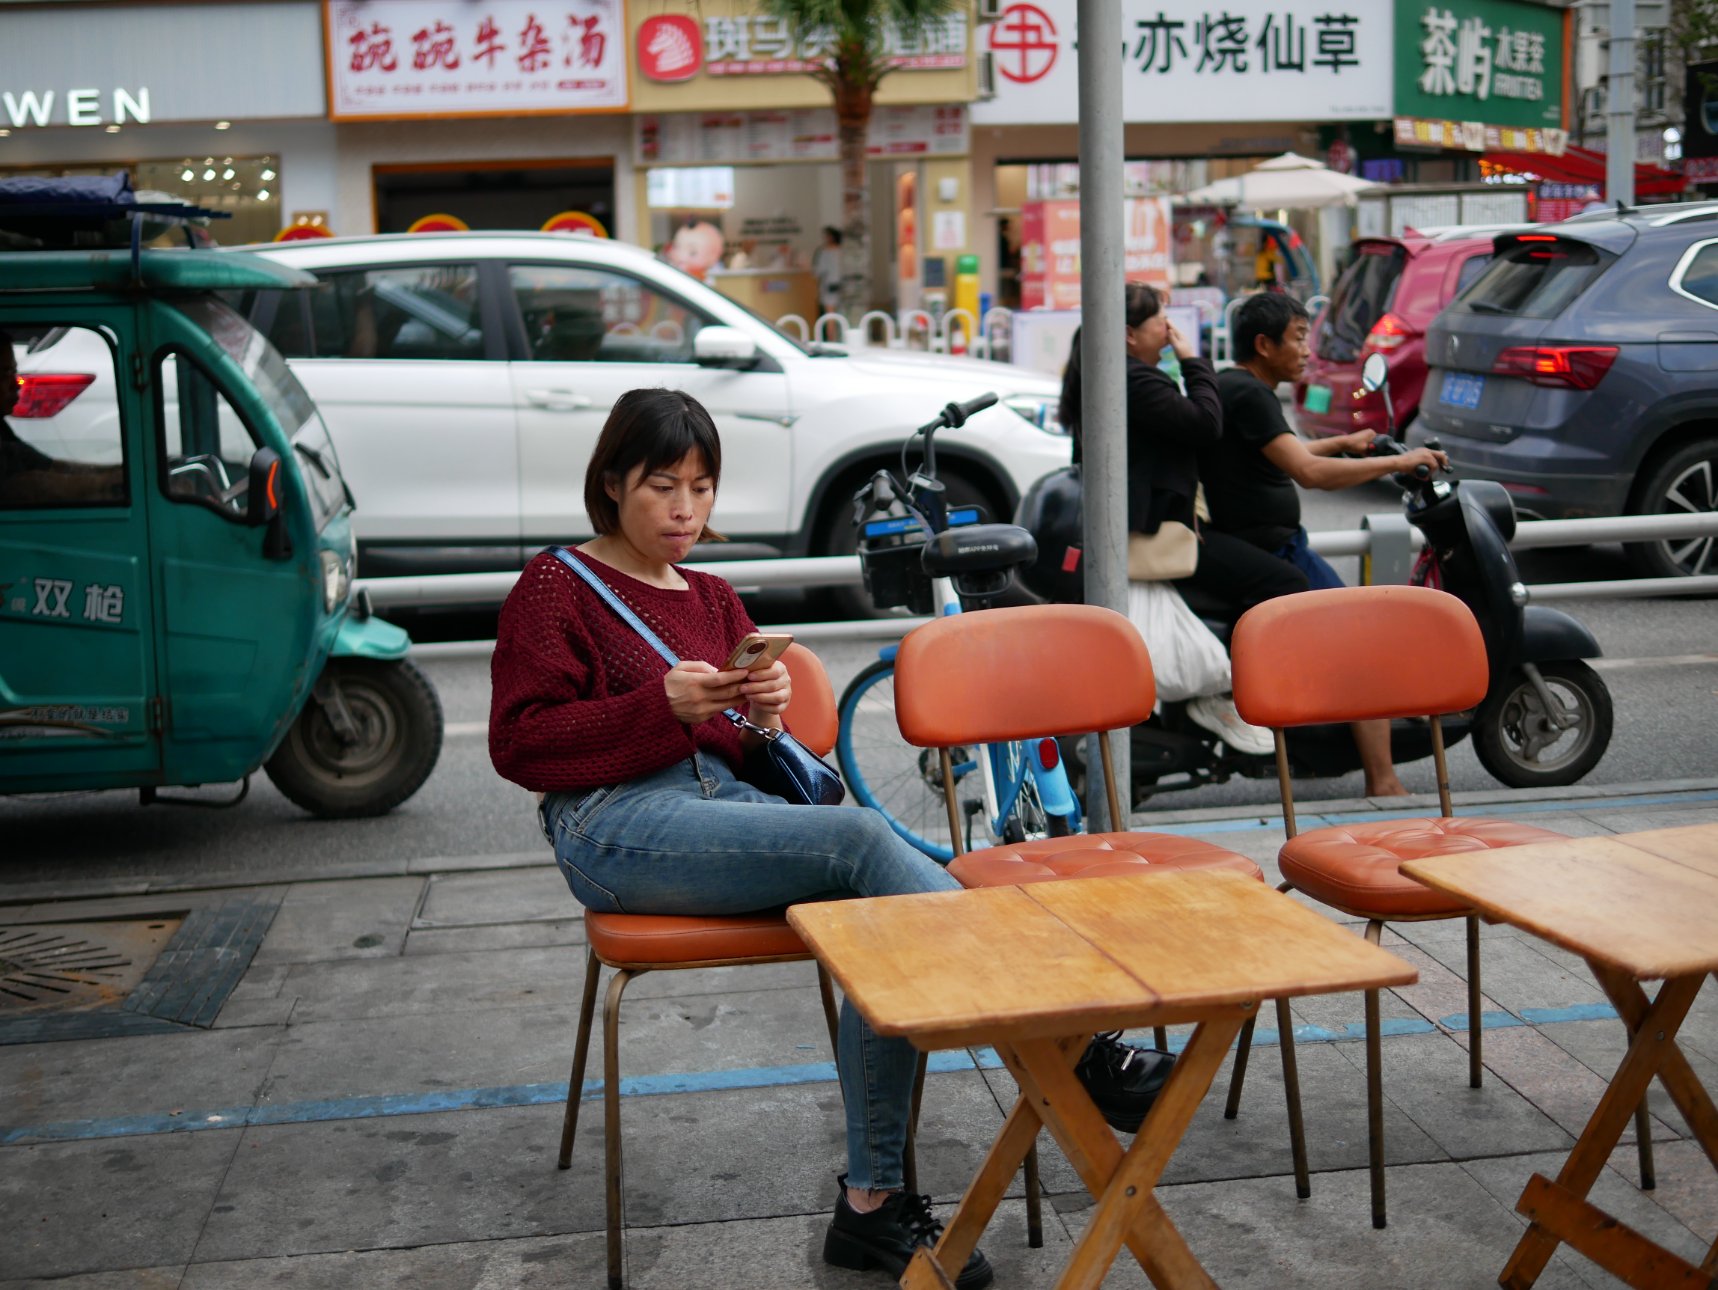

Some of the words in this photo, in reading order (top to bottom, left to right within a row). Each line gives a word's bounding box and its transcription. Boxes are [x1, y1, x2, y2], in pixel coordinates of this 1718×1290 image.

[347, 14, 608, 72] 碗碗牛杂汤
[1073, 12, 1361, 75] 亦烧仙草
[2, 86, 151, 127] WEN
[32, 578, 124, 623] 双枪
